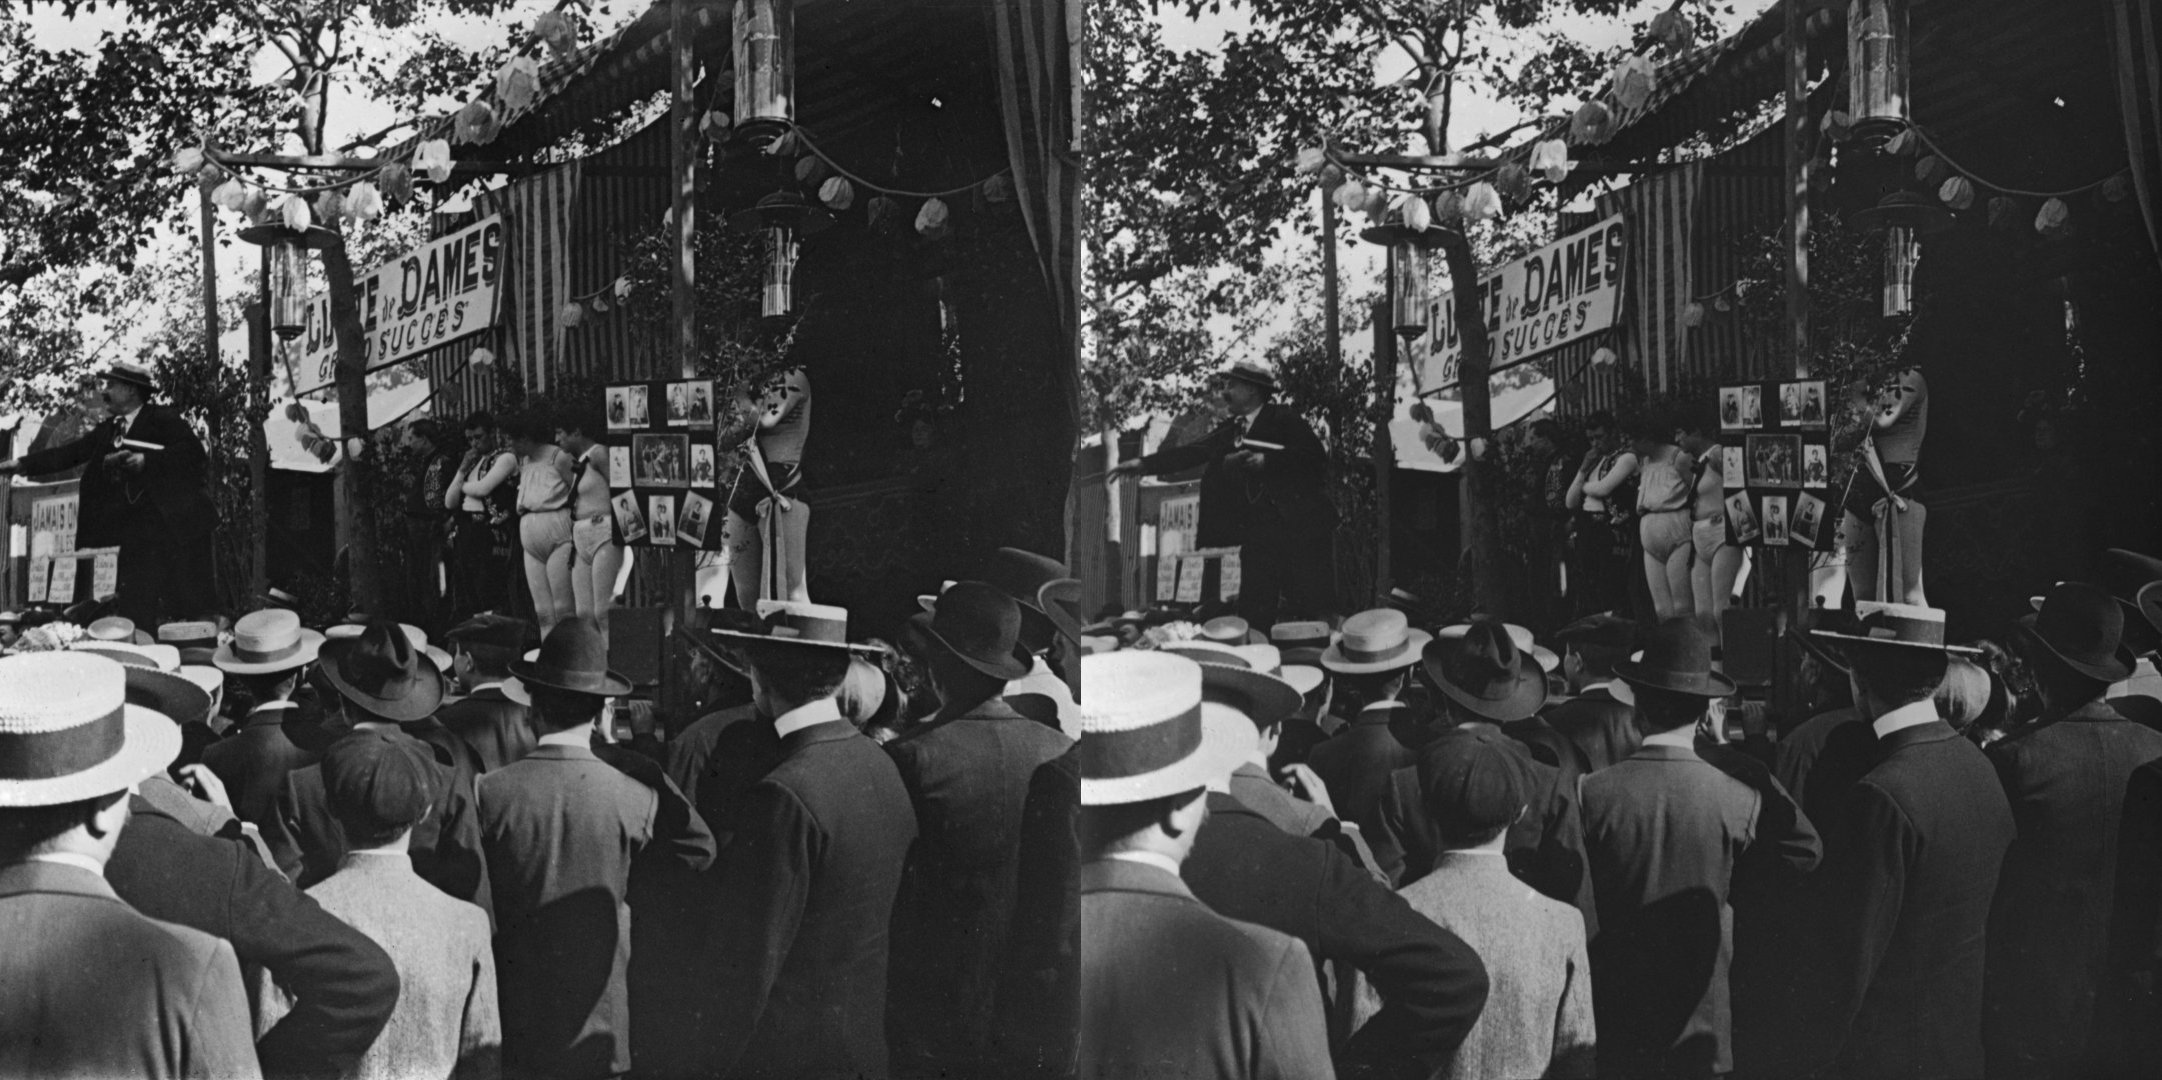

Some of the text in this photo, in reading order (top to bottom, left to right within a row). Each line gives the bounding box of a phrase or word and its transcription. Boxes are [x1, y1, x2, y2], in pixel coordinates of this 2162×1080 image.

[306, 222, 501, 356] LUTE de DAMES
[1430, 222, 1623, 356] LUTE de DAMES
